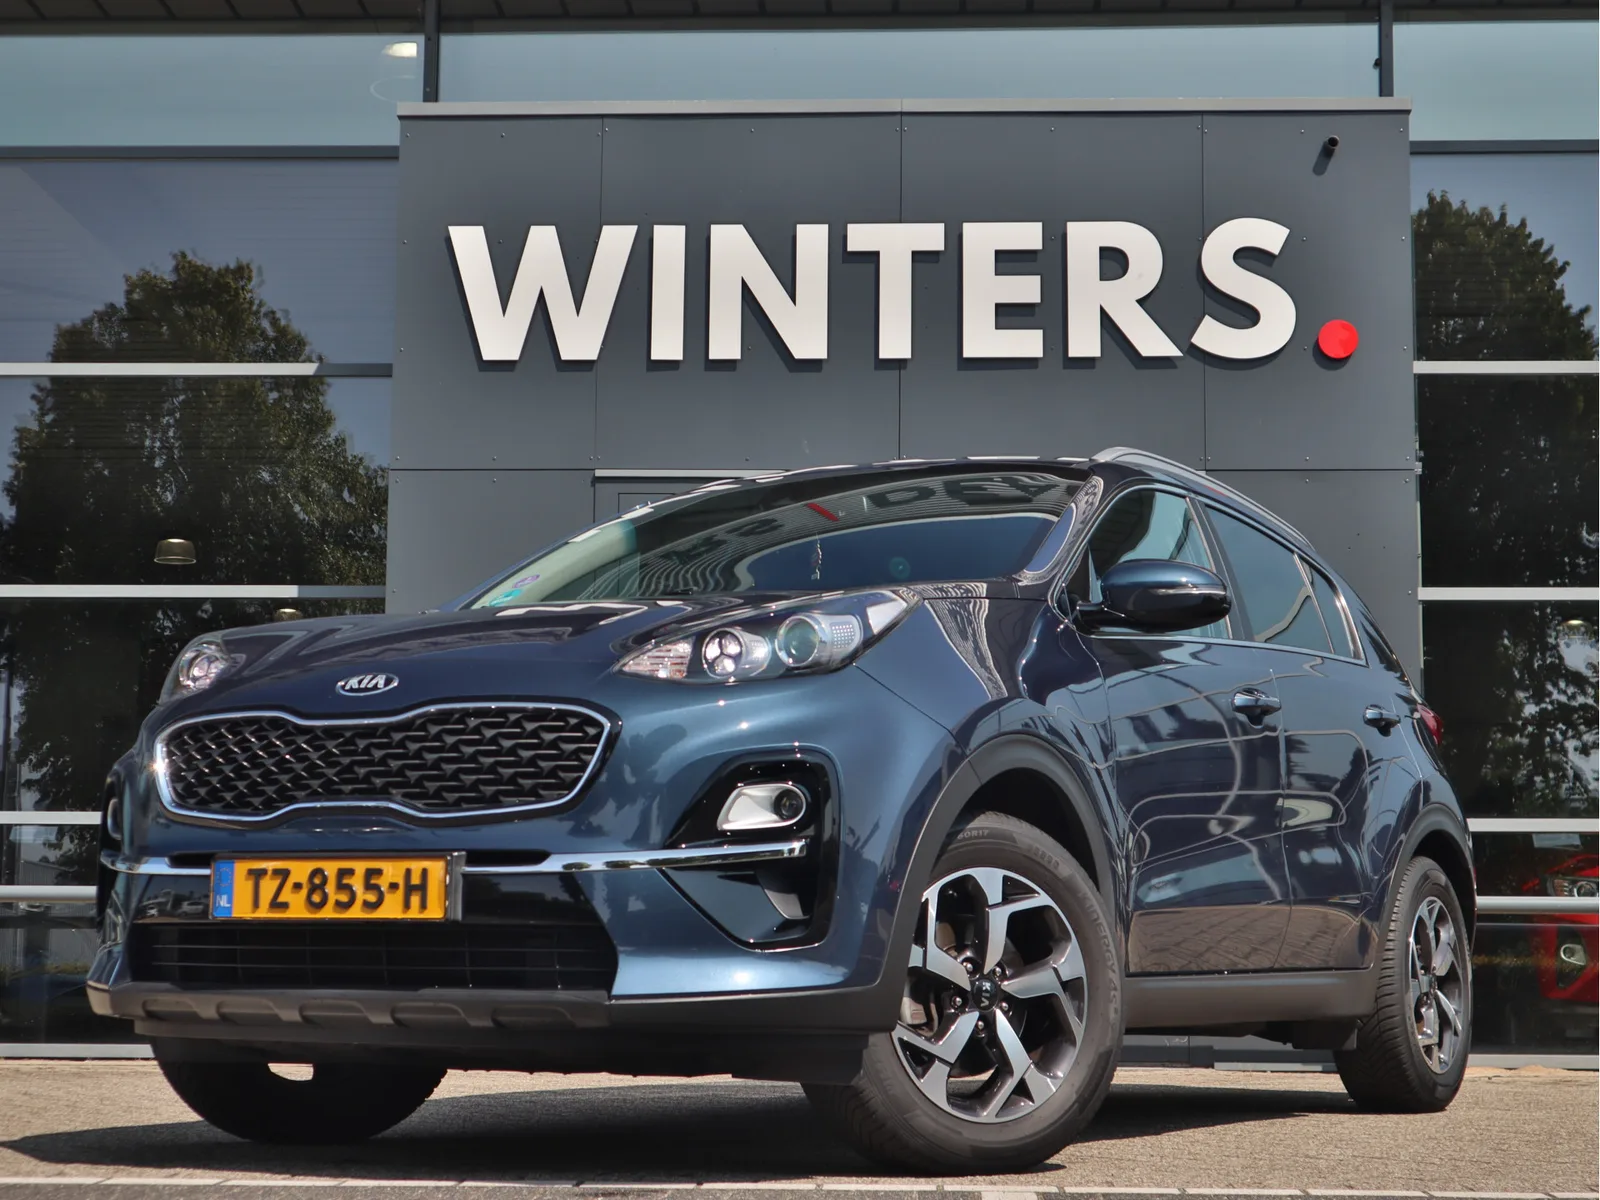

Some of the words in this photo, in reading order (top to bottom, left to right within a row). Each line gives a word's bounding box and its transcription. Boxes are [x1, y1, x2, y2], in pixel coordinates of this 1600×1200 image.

[344, 674, 386, 690] KIA
[246, 867, 428, 911] TZ-855-H
[216, 894, 231, 908] NL
[980, 981, 991, 1008] KIA
